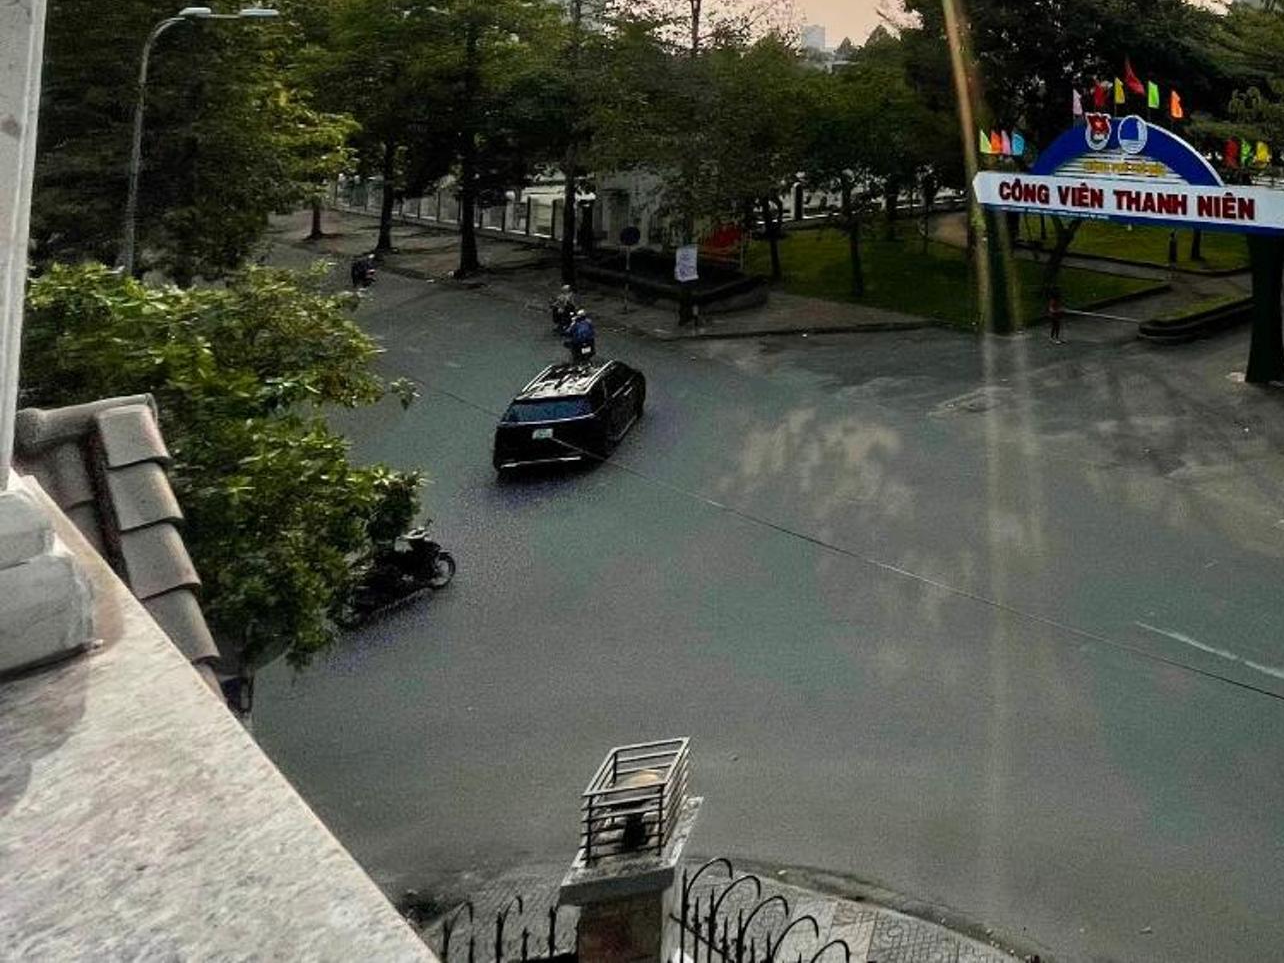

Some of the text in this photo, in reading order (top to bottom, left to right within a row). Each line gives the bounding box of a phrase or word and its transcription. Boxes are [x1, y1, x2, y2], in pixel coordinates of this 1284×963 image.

[998, 178, 1050, 205] CÔNG
[1057, 182, 1104, 209] VIÊN
[1113, 189, 1188, 215] THANH
[1197, 192, 1255, 220] NIÊN
